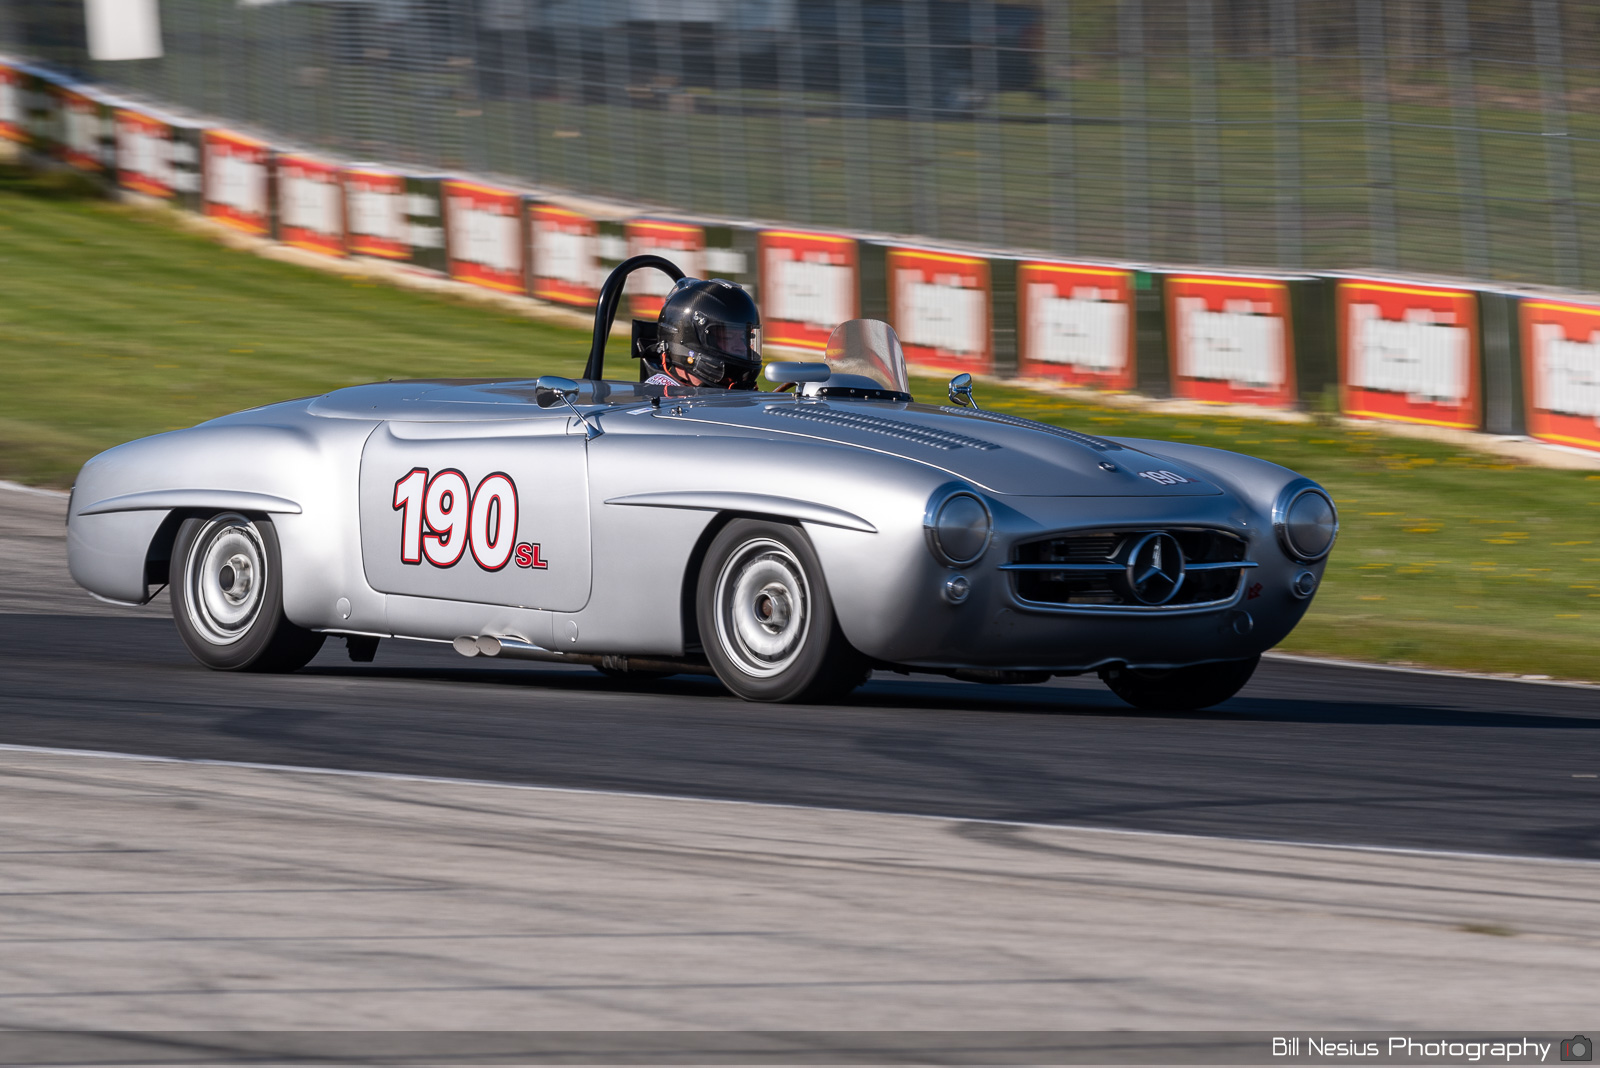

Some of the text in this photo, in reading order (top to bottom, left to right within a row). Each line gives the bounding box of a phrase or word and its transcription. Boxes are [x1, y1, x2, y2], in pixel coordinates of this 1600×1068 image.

[1138, 470, 1190, 485] 190
[392, 467, 548, 573] 190 SL
